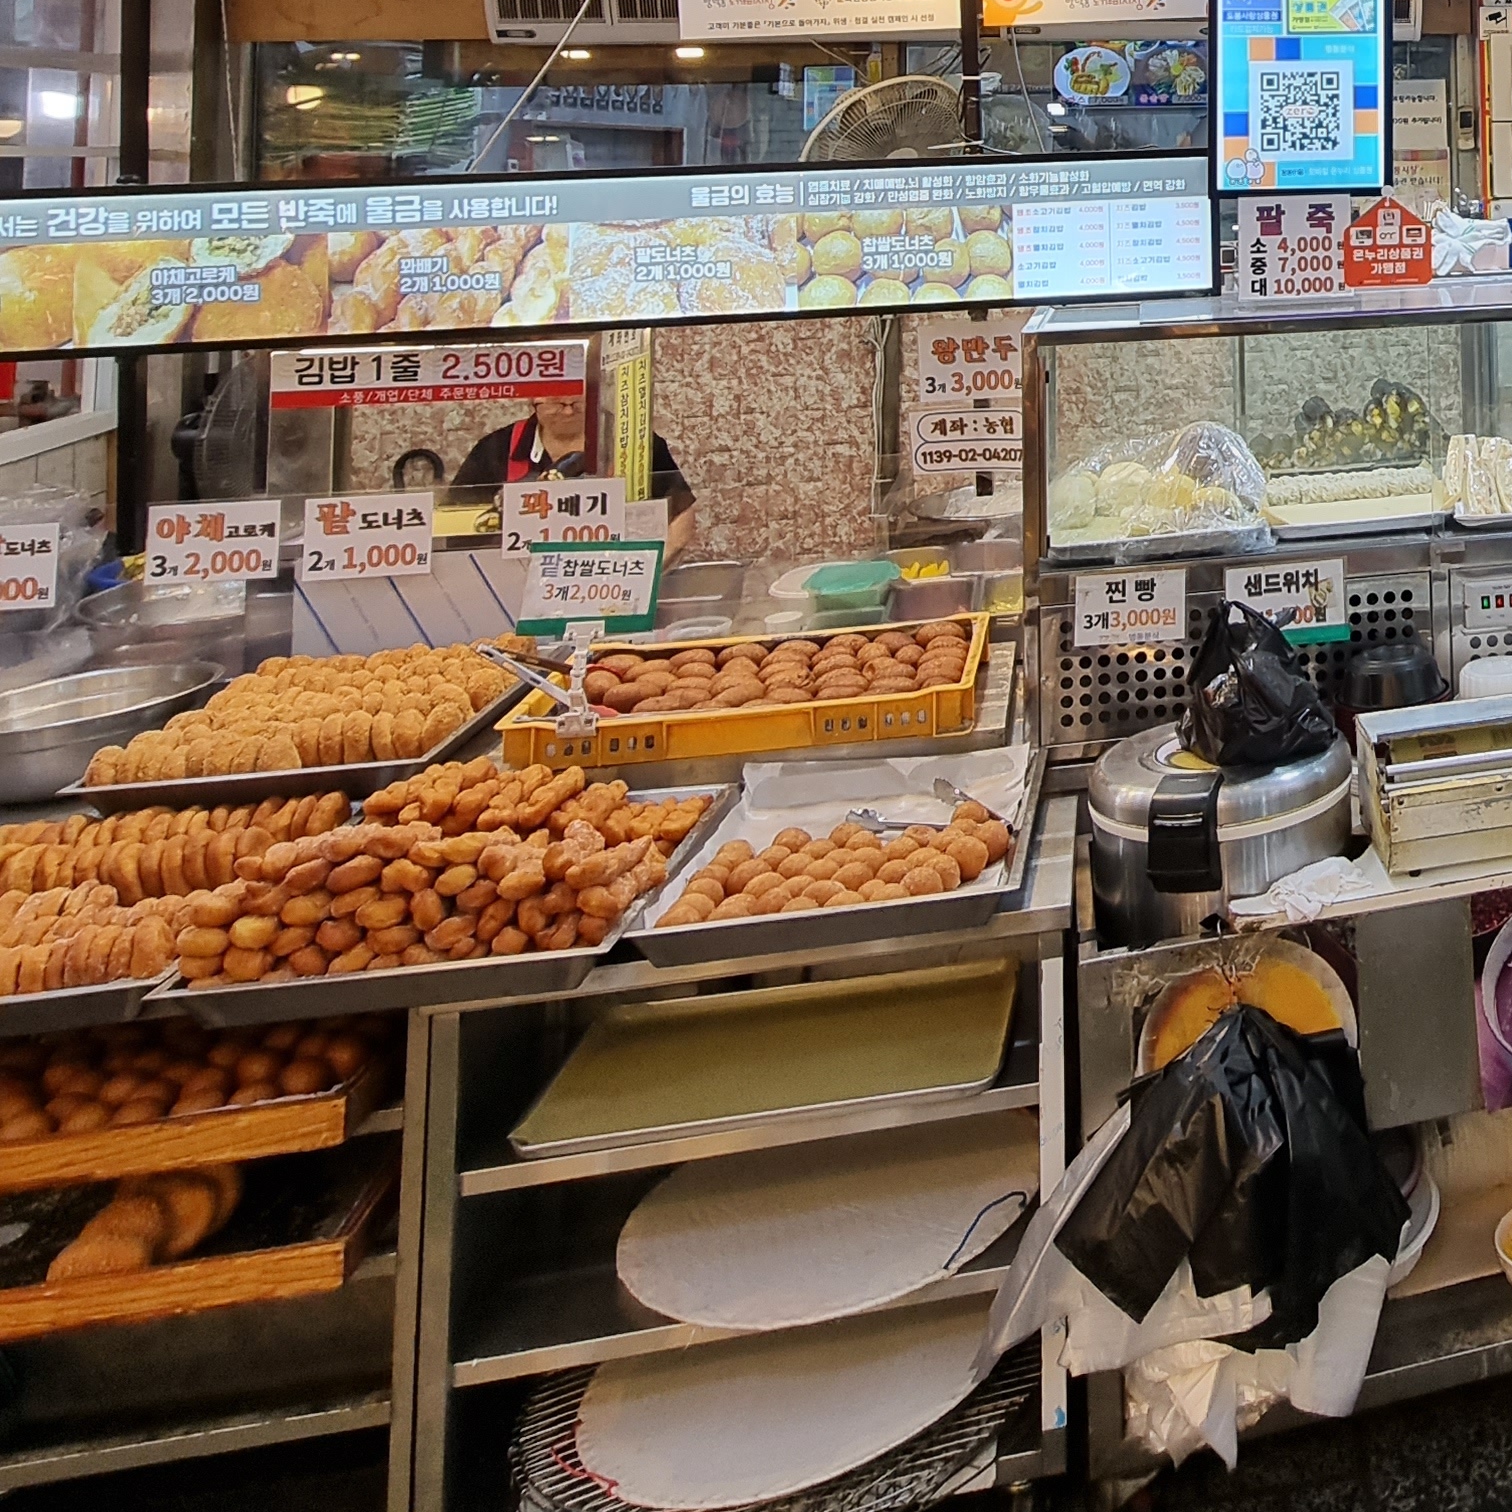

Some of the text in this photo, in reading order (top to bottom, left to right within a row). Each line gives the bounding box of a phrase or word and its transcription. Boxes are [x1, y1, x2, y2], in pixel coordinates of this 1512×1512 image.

[691, 183, 794, 208] 울금의 효능
[47, 207, 129, 238] 건강을
[135, 208, 201, 233] 위하여
[210, 202, 269, 231] 모든
[278, 198, 357, 228] 반죽에
[366, 195, 443, 223] 울금을
[448, 194, 558, 221] 사용합니다!
[862, 234, 934, 253] 찹쌀도너츠
[1250, 238, 1267, 254] 소
[1353, 247, 1423, 261] 온누리상품권
[401, 257, 448, 275] 꽈배기
[863, 249, 953, 270] 3개 1,000원
[1250, 257, 1267, 275] 중
[151, 264, 236, 287] 야채고로케
[635, 260, 732, 281] 2개 1,000원
[401, 272, 500, 293] 2개 1,000원
[1251, 277, 1267, 296] 대
[151, 283, 260, 304] 3개 2,000원
[932, 335, 1018, 365] 왕만두
[295, 354, 359, 386] 김밥
[371, 352, 421, 382] 1줄
[442, 349, 566, 383] 2.500원
[925, 376, 946, 393] 3개
[931, 416, 1014, 436] 계좌 농협
[519, 490, 608, 519] 꽈배기
[150, 548, 272, 579] 3개 2,000원
[309, 543, 428, 574] 2개 1,000원
